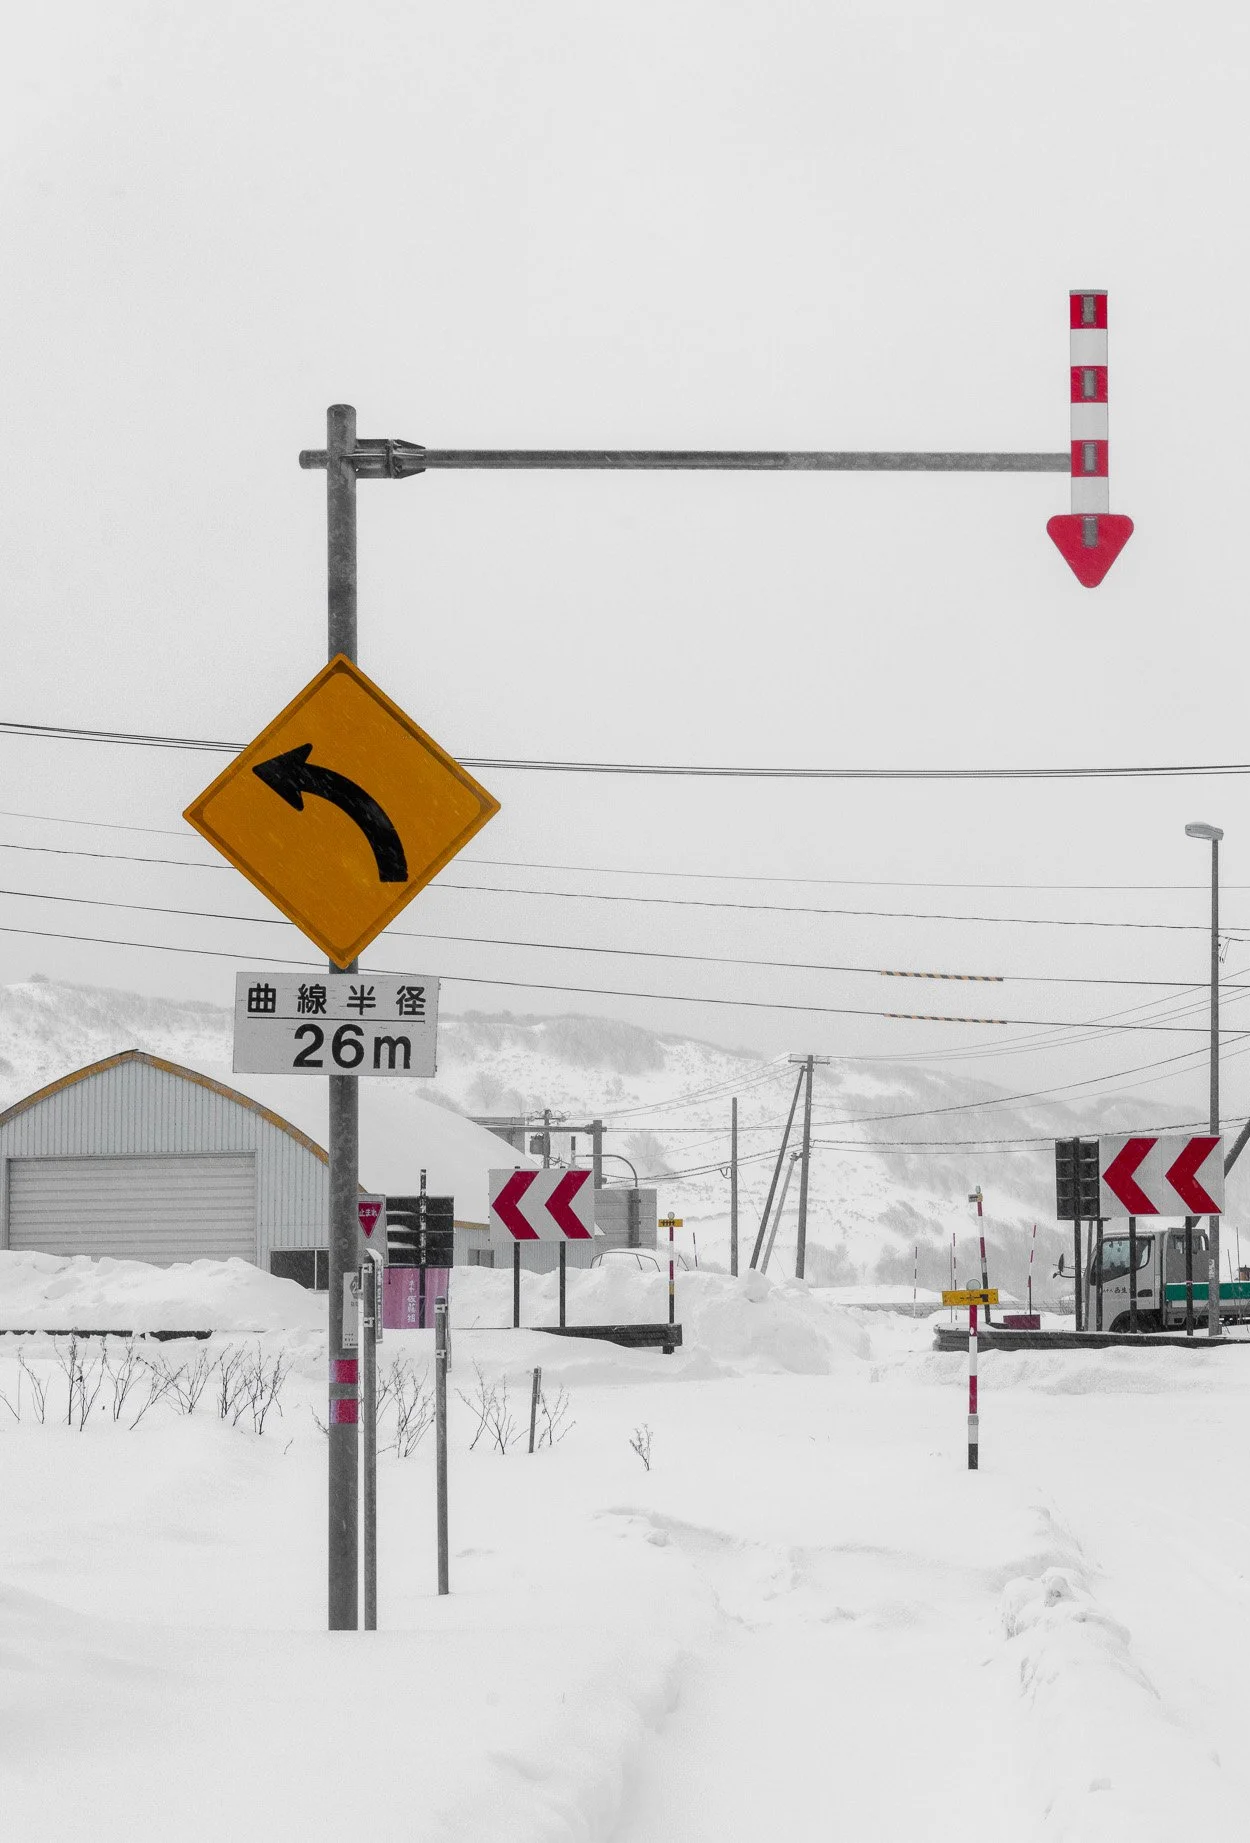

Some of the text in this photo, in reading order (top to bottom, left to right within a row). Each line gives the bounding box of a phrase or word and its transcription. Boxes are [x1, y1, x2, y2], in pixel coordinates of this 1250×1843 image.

[247, 983, 426, 1016] 曲線半径
[293, 1023, 412, 1070] 26m
